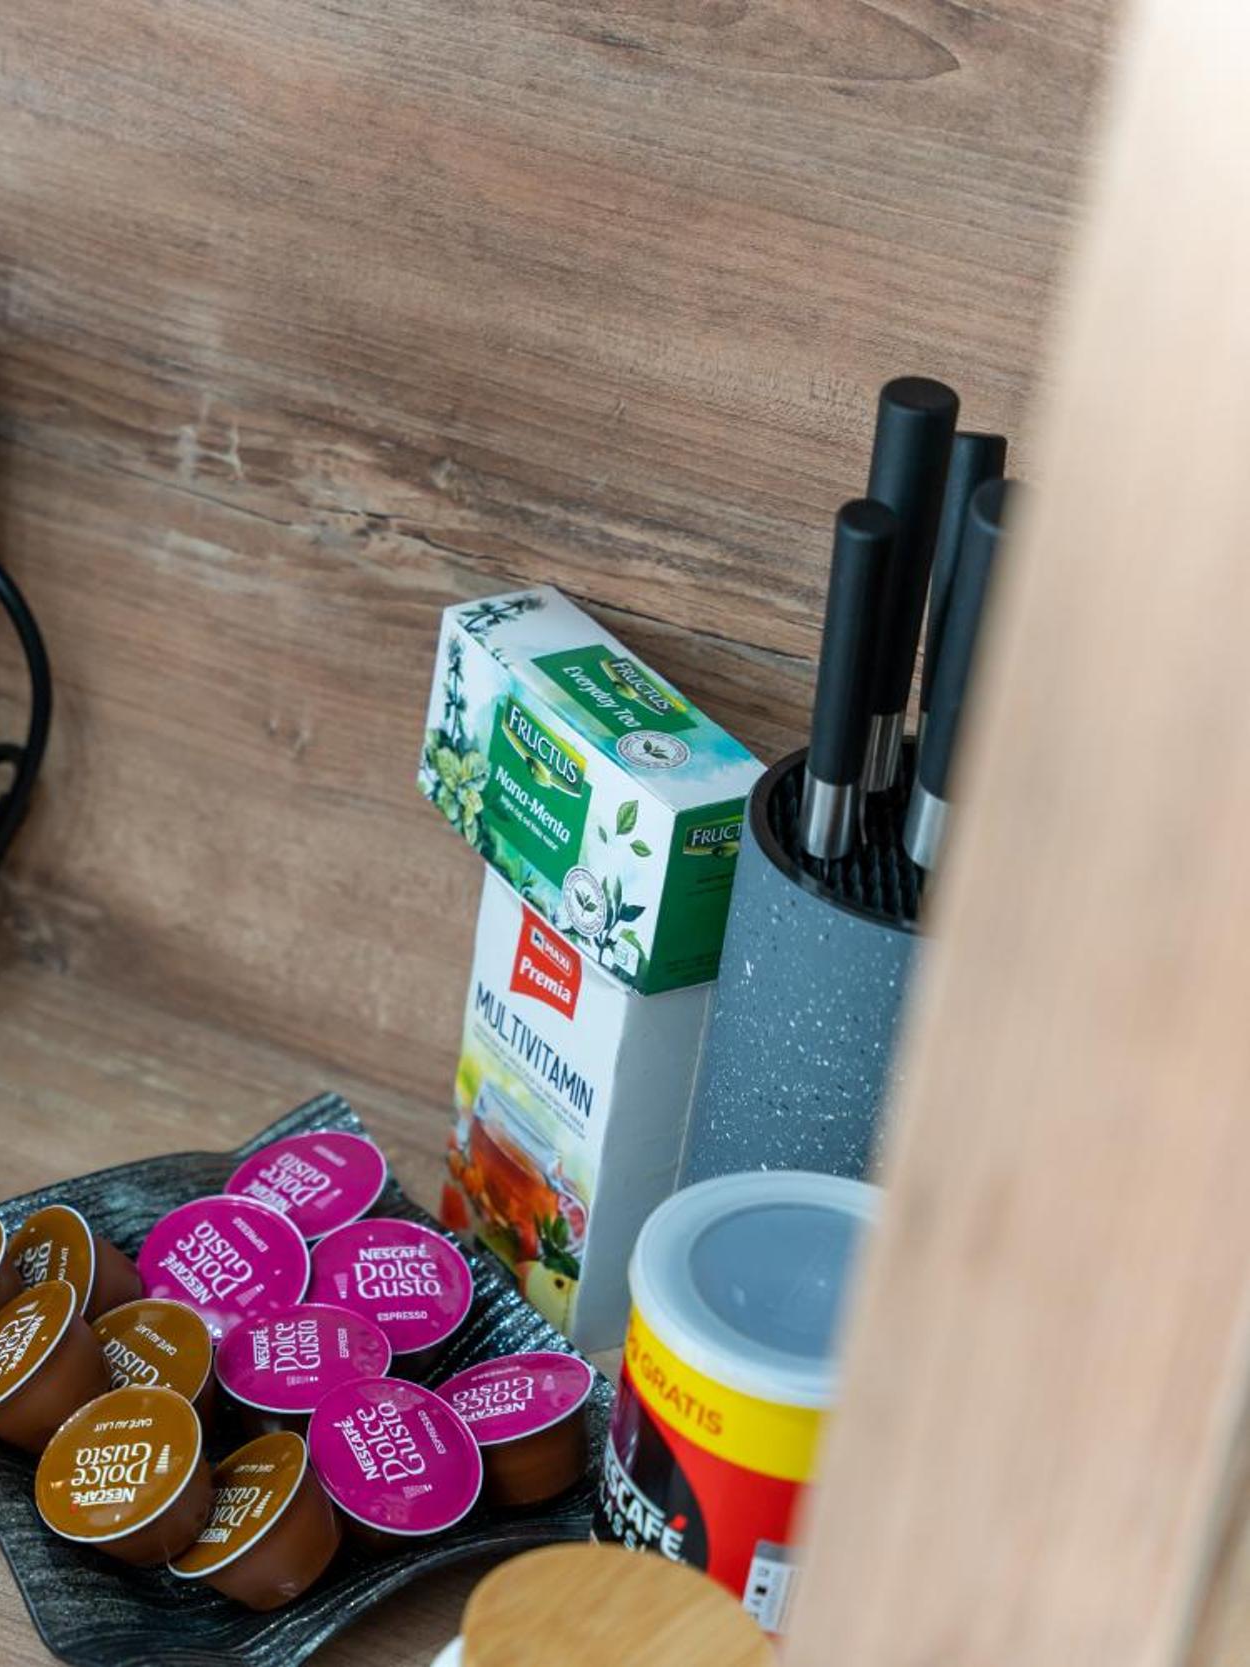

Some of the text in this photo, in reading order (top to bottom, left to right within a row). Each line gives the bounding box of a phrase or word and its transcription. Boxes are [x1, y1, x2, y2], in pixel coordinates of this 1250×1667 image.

[562, 666, 642, 728] Everyday Tea
[610, 660, 674, 711] FRUCTUS
[508, 704, 580, 785] FRUCTUS
[495, 765, 571, 844] Nana-Menta
[691, 823, 742, 847] FRUCT
[519, 955, 571, 1005] Premia
[475, 981, 594, 1118] MULTIVITAMIN
[258, 1164, 318, 1207] Dolce
[276, 1152, 331, 1191] Gusto
[176, 1233, 240, 1301] Dolce
[194, 1220, 253, 1283] Gusto
[352, 1260, 438, 1282] Dolce
[357, 1278, 442, 1300] Gusto
[376, 1310, 428, 1322] ESPRESSO
[103, 1337, 159, 1386] Gusto
[271, 1321, 297, 1374] Dolce
[297, 1319, 321, 1370] Gusto
[452, 1376, 534, 1402] Gusto
[453, 1387, 534, 1413] Dolce
[641, 1351, 723, 1436] GRATIS
[76, 1442, 152, 1467] Gusto
[356, 1406, 409, 1484] Dolce
[378, 1400, 426, 1475] Gusto
[71, 1461, 150, 1488] Dolce
